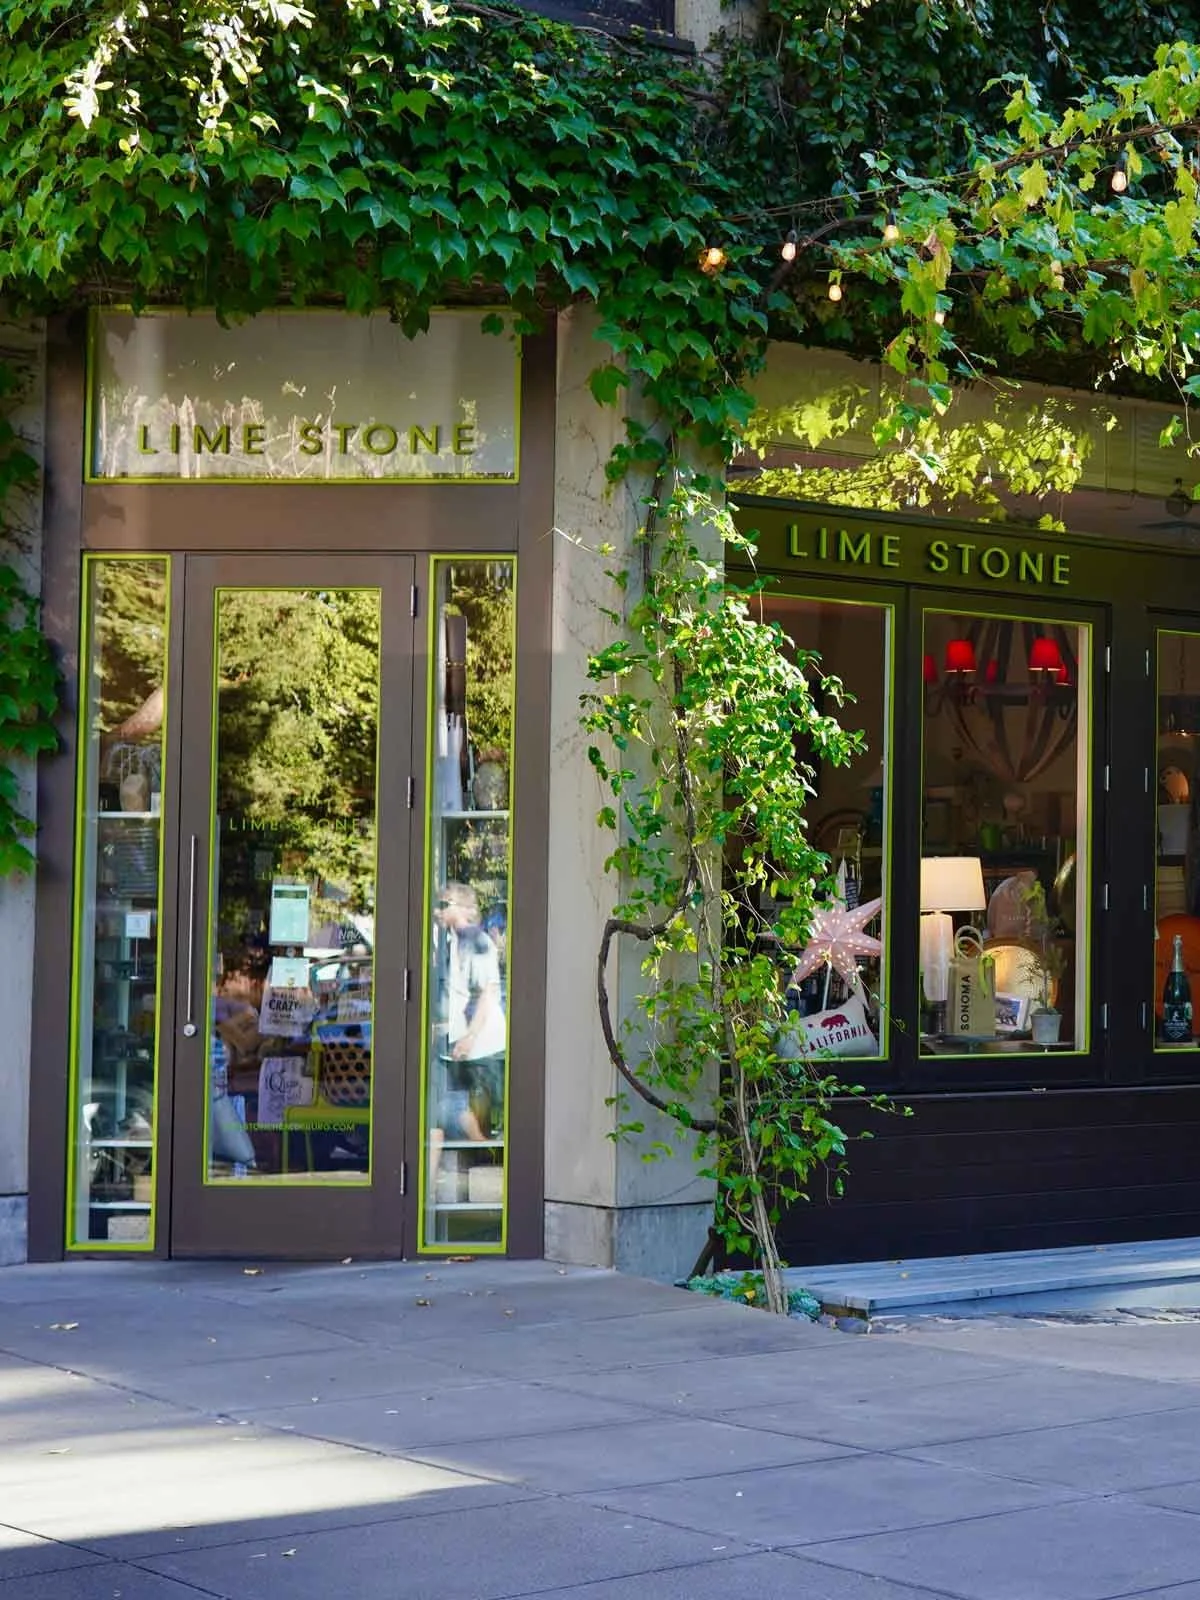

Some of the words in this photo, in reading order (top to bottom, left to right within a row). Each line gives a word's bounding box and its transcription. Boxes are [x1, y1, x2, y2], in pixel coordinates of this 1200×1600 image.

[138, 423, 267, 456] LIME
[299, 422, 478, 456] STONE
[787, 523, 902, 568] LIME
[927, 540, 1072, 586] STONE
[960, 975, 971, 1031] SONOMA
